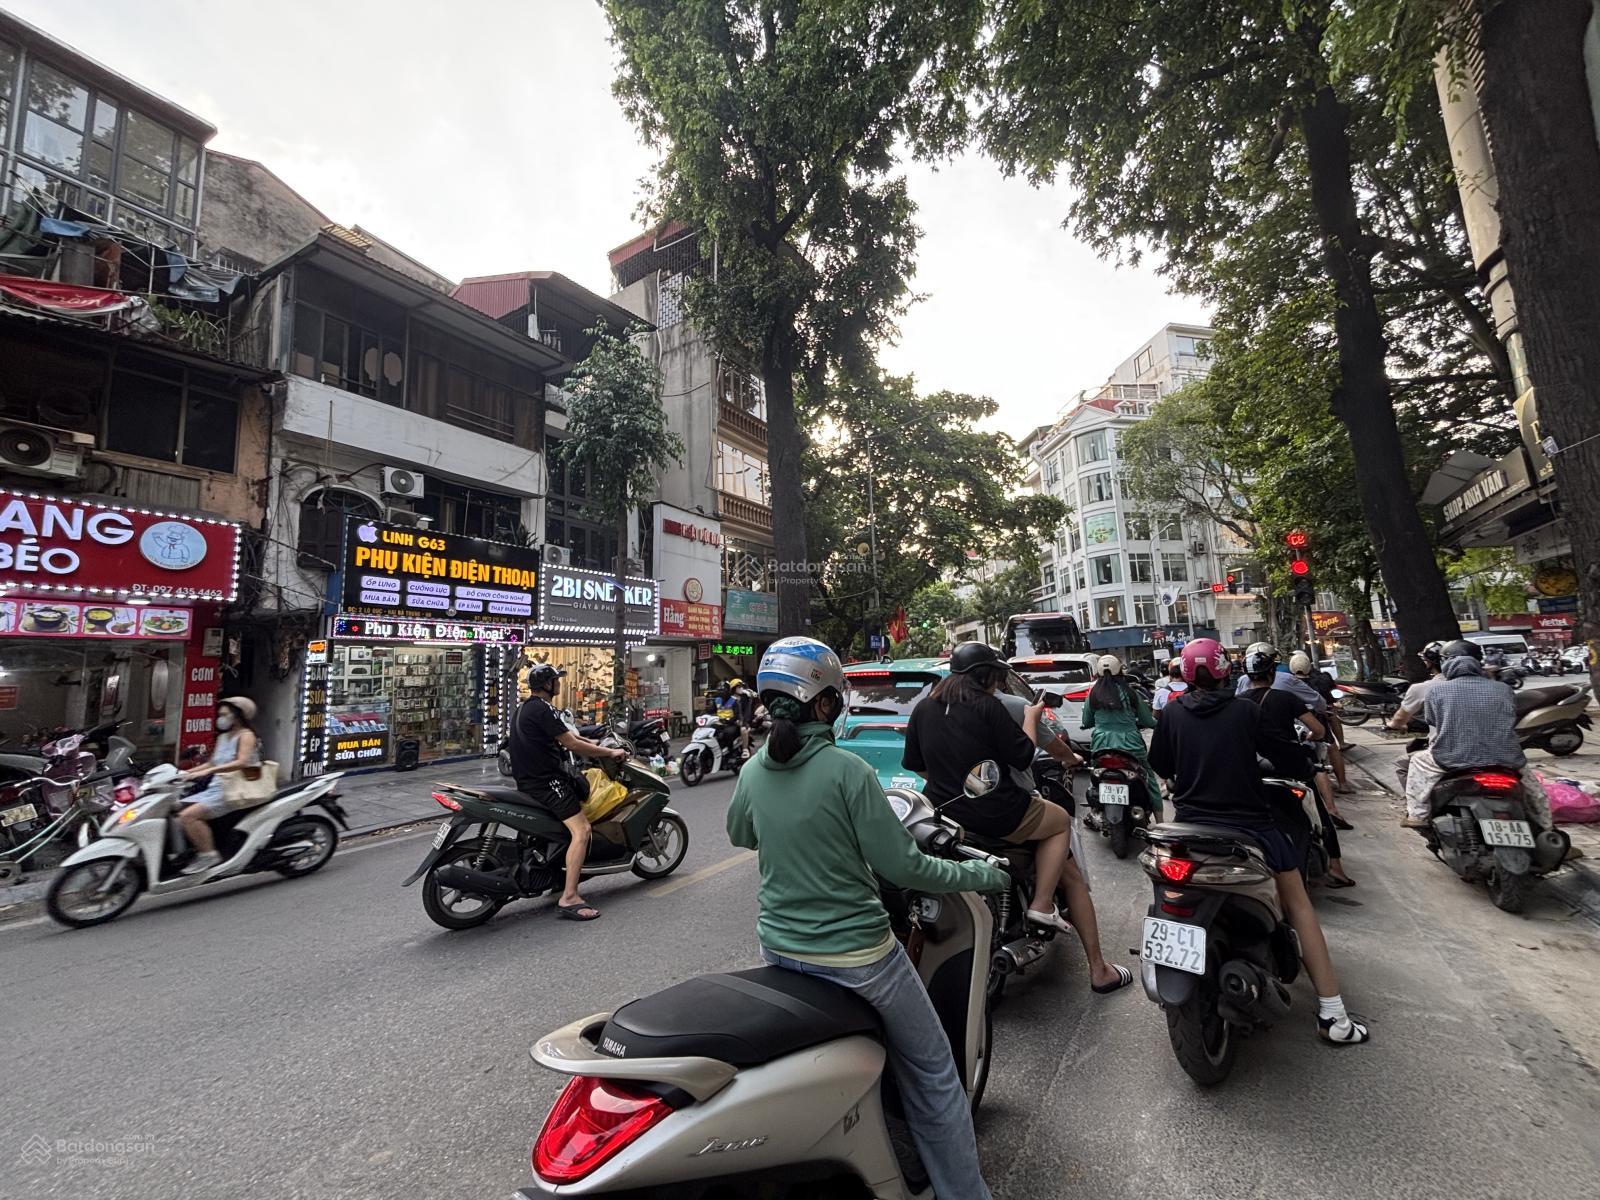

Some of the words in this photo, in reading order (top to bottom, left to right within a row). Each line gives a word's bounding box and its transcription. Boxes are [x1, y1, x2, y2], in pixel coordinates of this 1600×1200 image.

[1442, 497, 1464, 523] SHOP
[1463, 488, 1483, 511] ANH
[1, 500, 134, 545] ANG
[382, 530, 413, 546] LINH
[418, 536, 446, 551] G63
[355, 546, 399, 576] PHỤ
[402, 552, 446, 579] KIỆN
[450, 558, 491, 584] ĐIỆN
[492, 566, 536, 590] THOẠI
[365, 576, 377, 587] ỐP
[364, 594, 381, 602] MUA
[383, 594, 397, 603] BÁN
[551, 575, 582, 599] 2BI
[583, 580, 652, 606] SNEKER
[466, 602, 481, 610] KÍNH
[573, 601, 592, 611] GIÀY
[365, 621, 392, 638] Phụ
[397, 622, 430, 639] Kiện
[435, 623, 468, 640] Điện
[191, 667, 214, 681] CƠM
[187, 693, 214, 708] RANG
[310, 735, 321, 753] ÉP
[337, 741, 359, 750] MUA
[362, 738, 381, 747] BÁN
[335, 749, 356, 760] SỬA
[357, 747, 382, 757] CHỮA
[303, 761, 324, 777] KÍNH
[1487, 832, 1532, 846] 151.75
[1151, 922, 1195, 947] 29-C1
[1144, 940, 1201, 970] 532.72
[602, 1036, 627, 1058] YAMAHA
